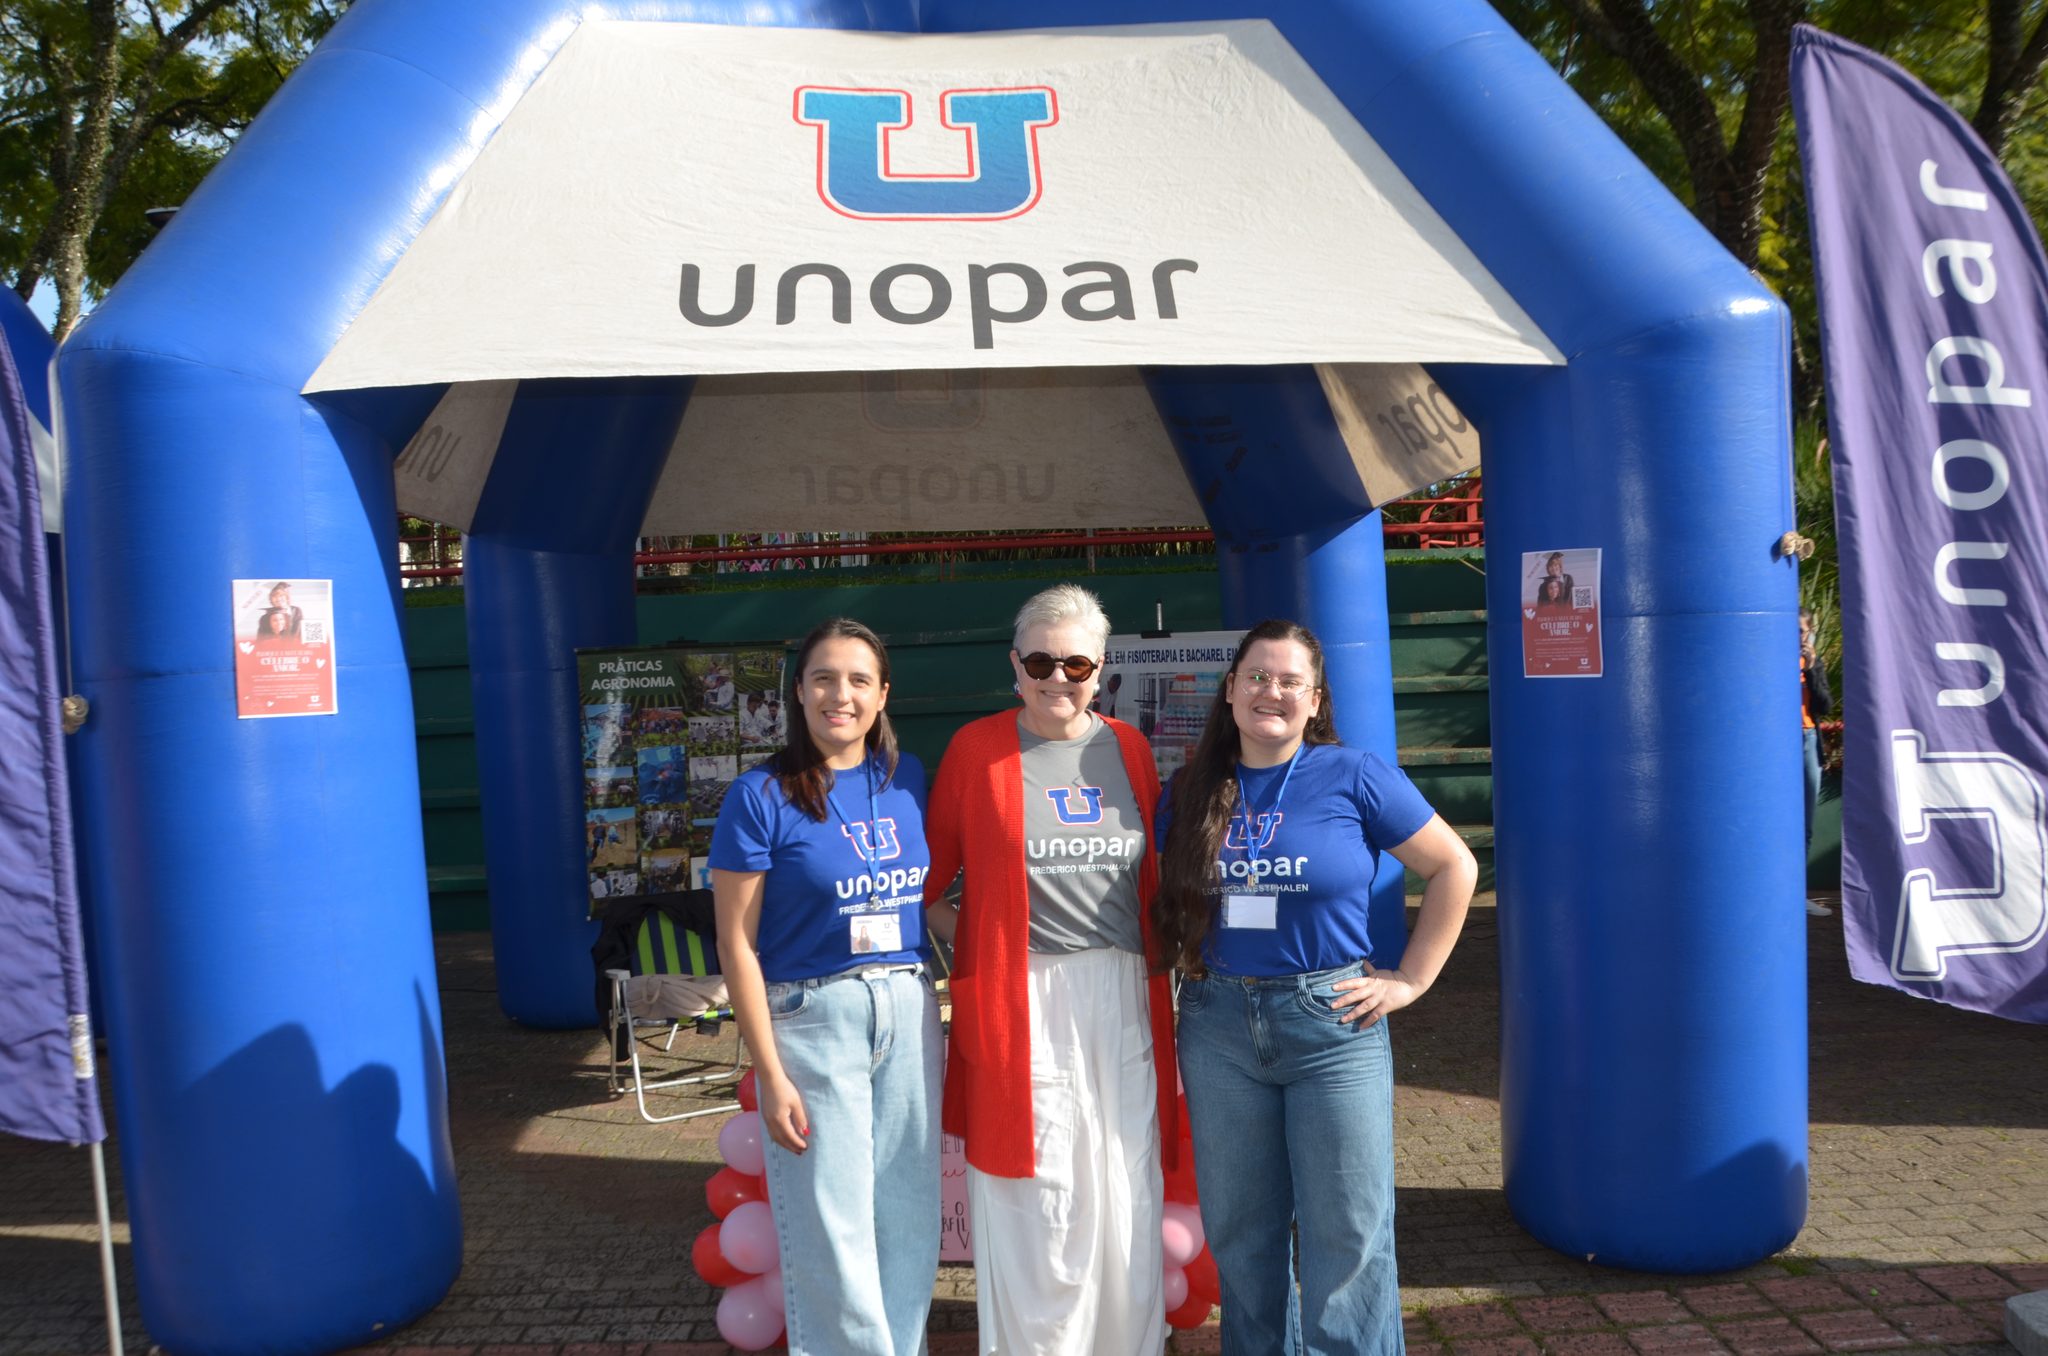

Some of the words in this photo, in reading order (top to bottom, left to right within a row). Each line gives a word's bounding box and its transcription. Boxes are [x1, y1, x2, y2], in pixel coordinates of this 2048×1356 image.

[792, 85, 1058, 221] U
[678, 258, 1199, 349] unopar
[1919, 158, 2031, 707] unopar
[599, 657, 663, 673] PRÁTICAS
[1116, 651, 1125, 664] EM
[1127, 649, 1177, 664] FISIOTERAPIA
[1180, 649, 1185, 663] E
[1186, 648, 1225, 663] BACHAREL
[591, 675, 675, 690] AGRONOMIA
[1044, 786, 1104, 826] U
[1028, 837, 1136, 863] unopar
[1030, 865, 1077, 875] FREDERICO
[1079, 863, 1130, 873] WESTPHALEN
[1209, 856, 1309, 882] nopar
[836, 866, 929, 899] unopar
